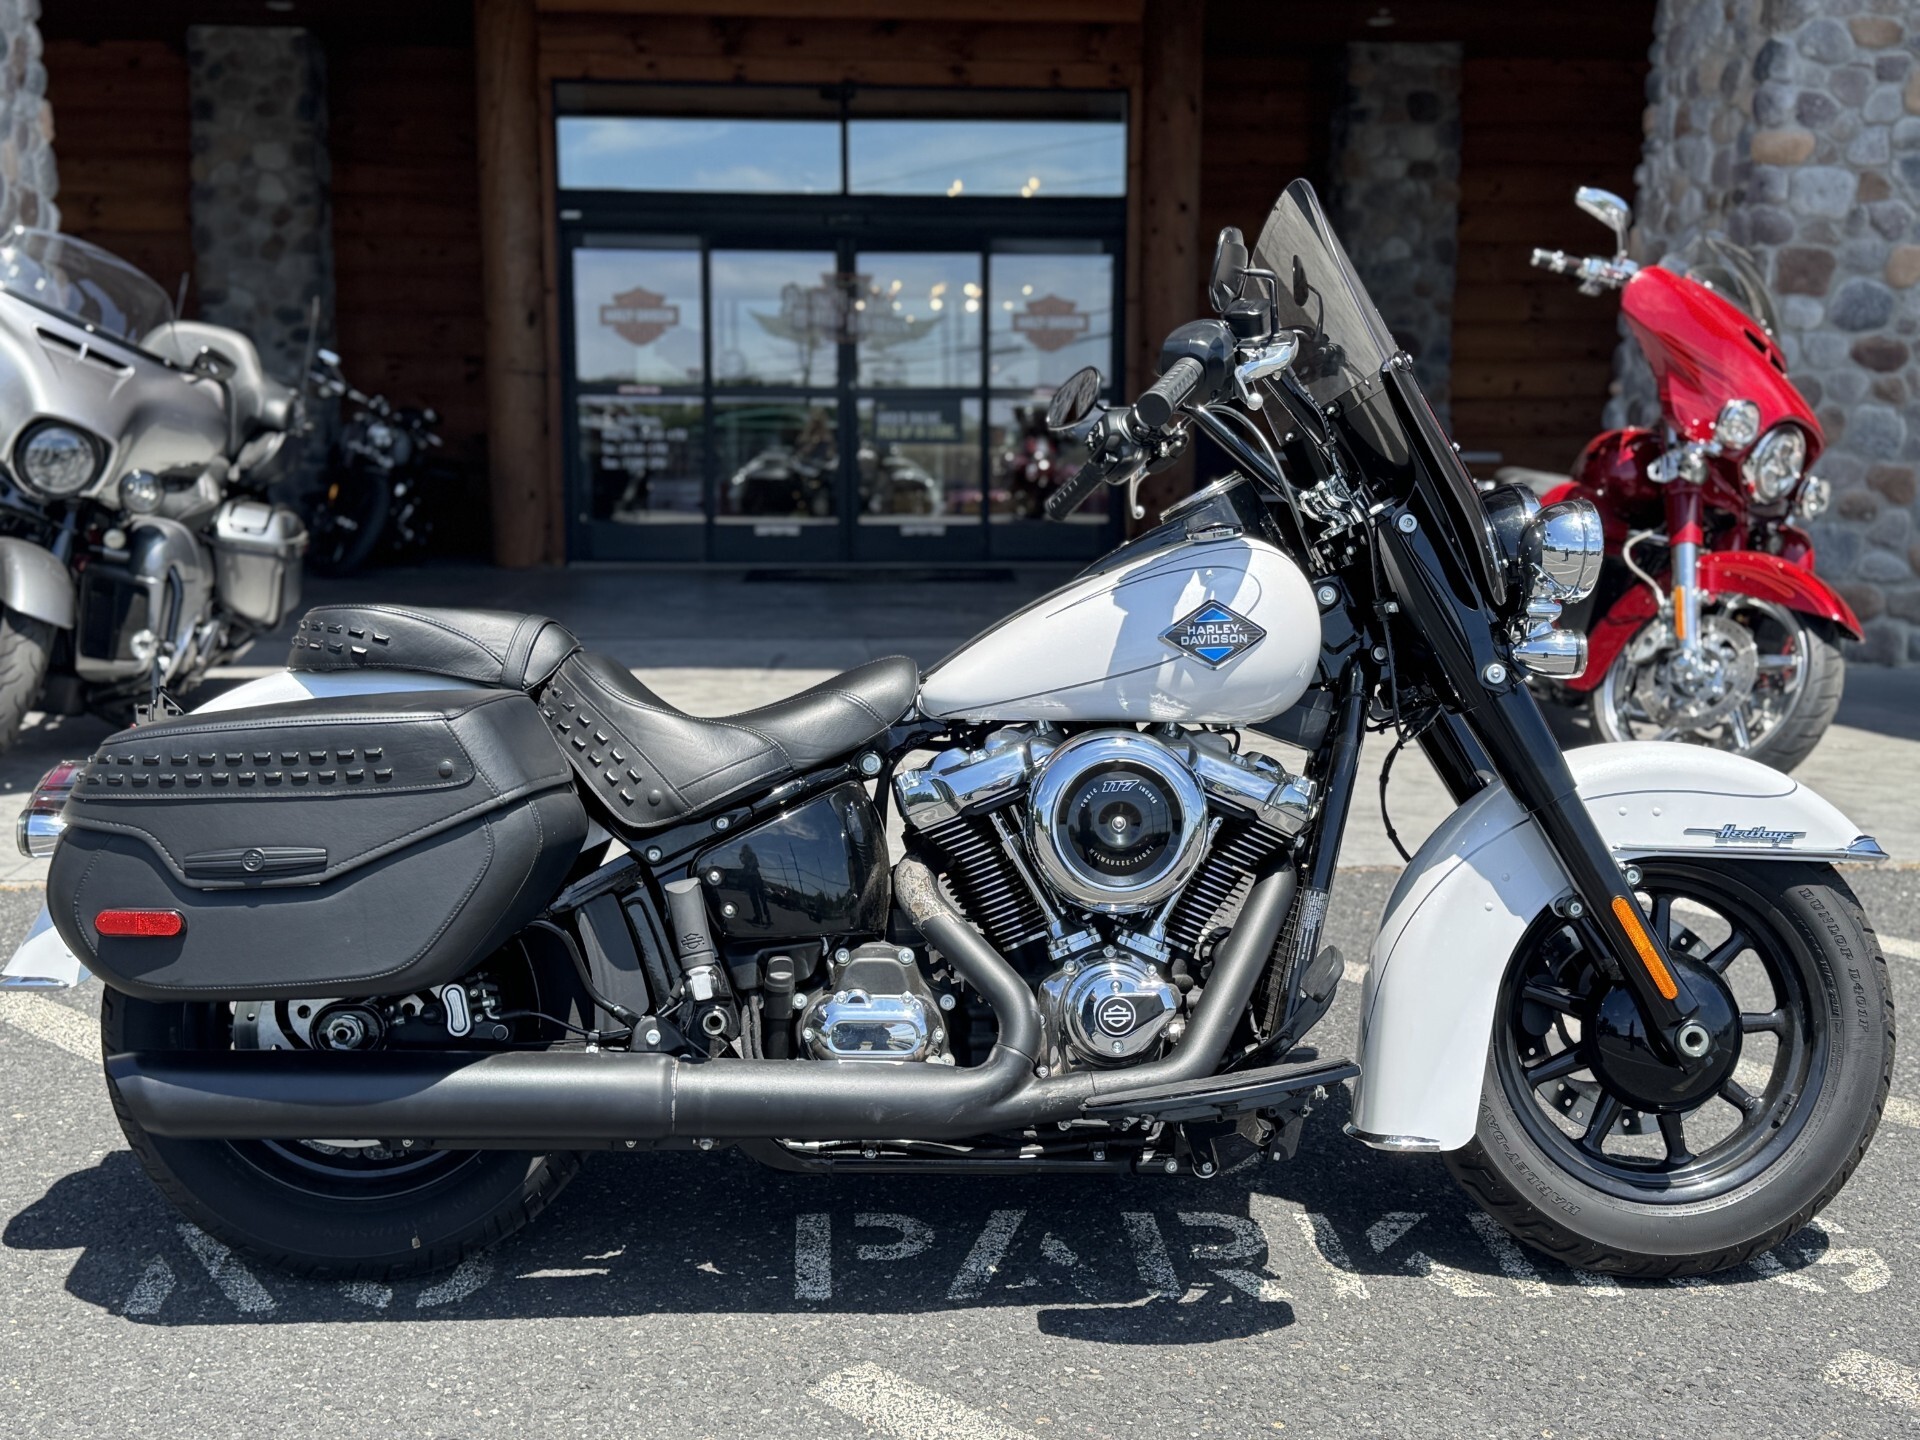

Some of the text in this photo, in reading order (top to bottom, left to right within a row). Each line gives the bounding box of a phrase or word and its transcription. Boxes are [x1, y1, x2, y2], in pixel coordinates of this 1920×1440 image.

[1187, 623, 1243, 635] HARLEY-
[1180, 633, 1248, 646] DAVIDSON
[1080, 779, 1158, 808] CUBIC 117 INCHES
[1717, 823, 1796, 842] Heritage
[1088, 845, 1155, 867] MILWAUKEE-EIGHT
[1798, 887, 1854, 961] DUNLOP
